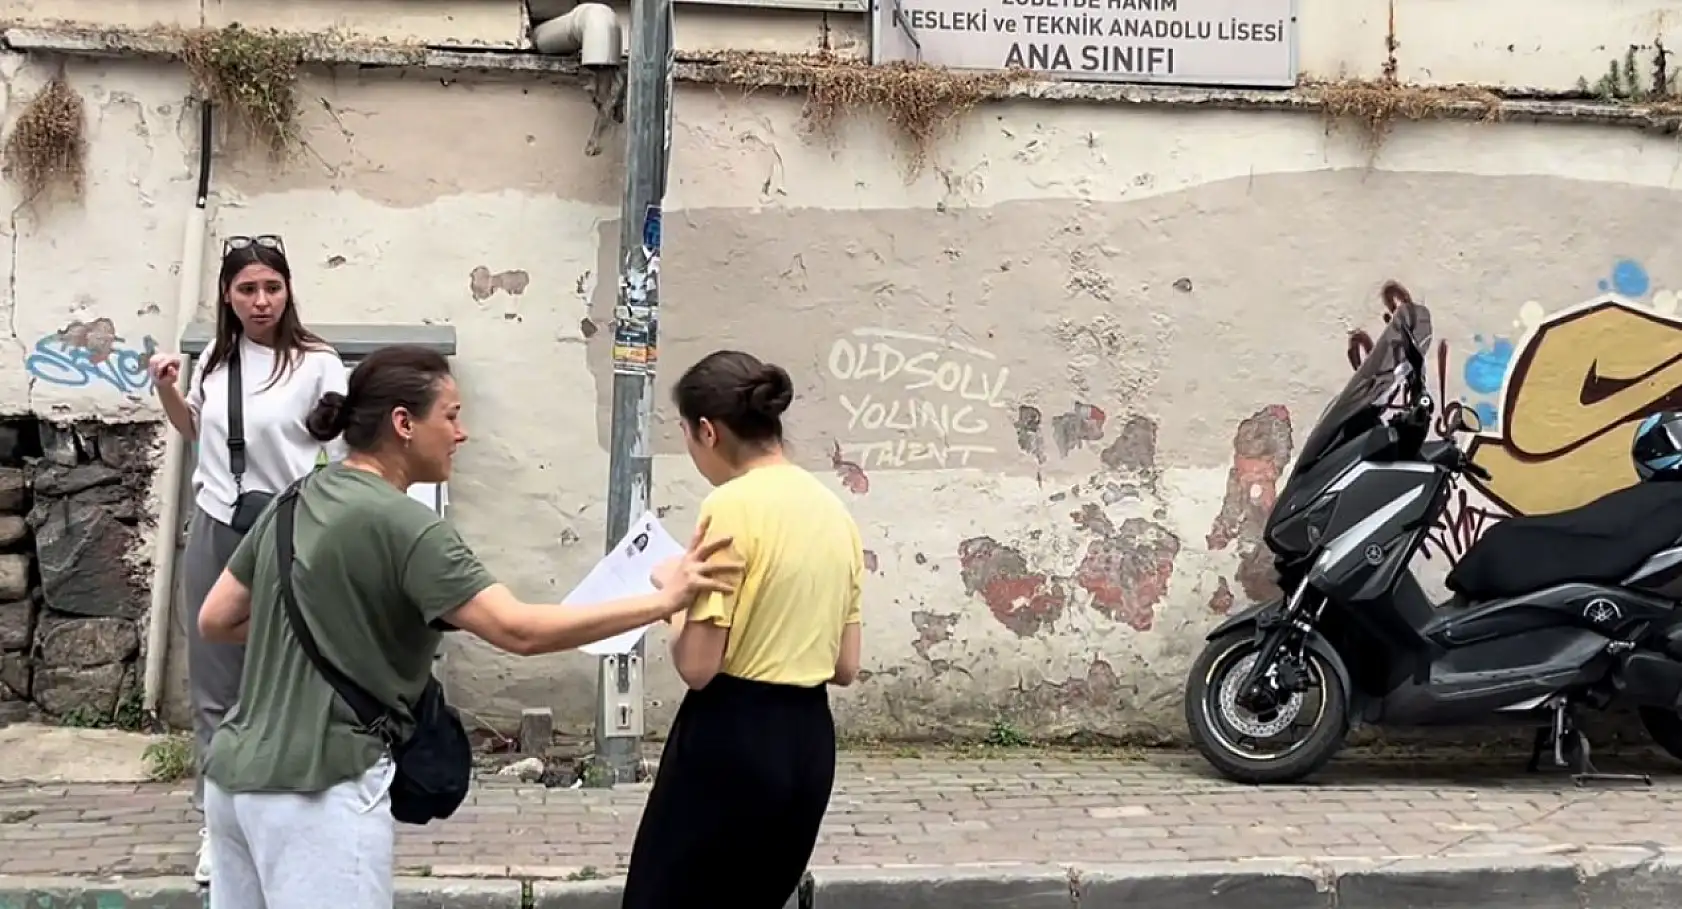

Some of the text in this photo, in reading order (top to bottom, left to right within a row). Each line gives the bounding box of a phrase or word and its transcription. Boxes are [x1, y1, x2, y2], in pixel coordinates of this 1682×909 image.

[993, 18, 1017, 33] ve
[1023, 13, 1103, 37] TEKNİK
[1108, 18, 1211, 39] ANADOLU
[1218, 18, 1283, 42] LİSESİ
[1004, 42, 1174, 74] ANA SINIFI
[838, 394, 989, 437] YOUNG
[840, 439, 998, 468] TALENT
